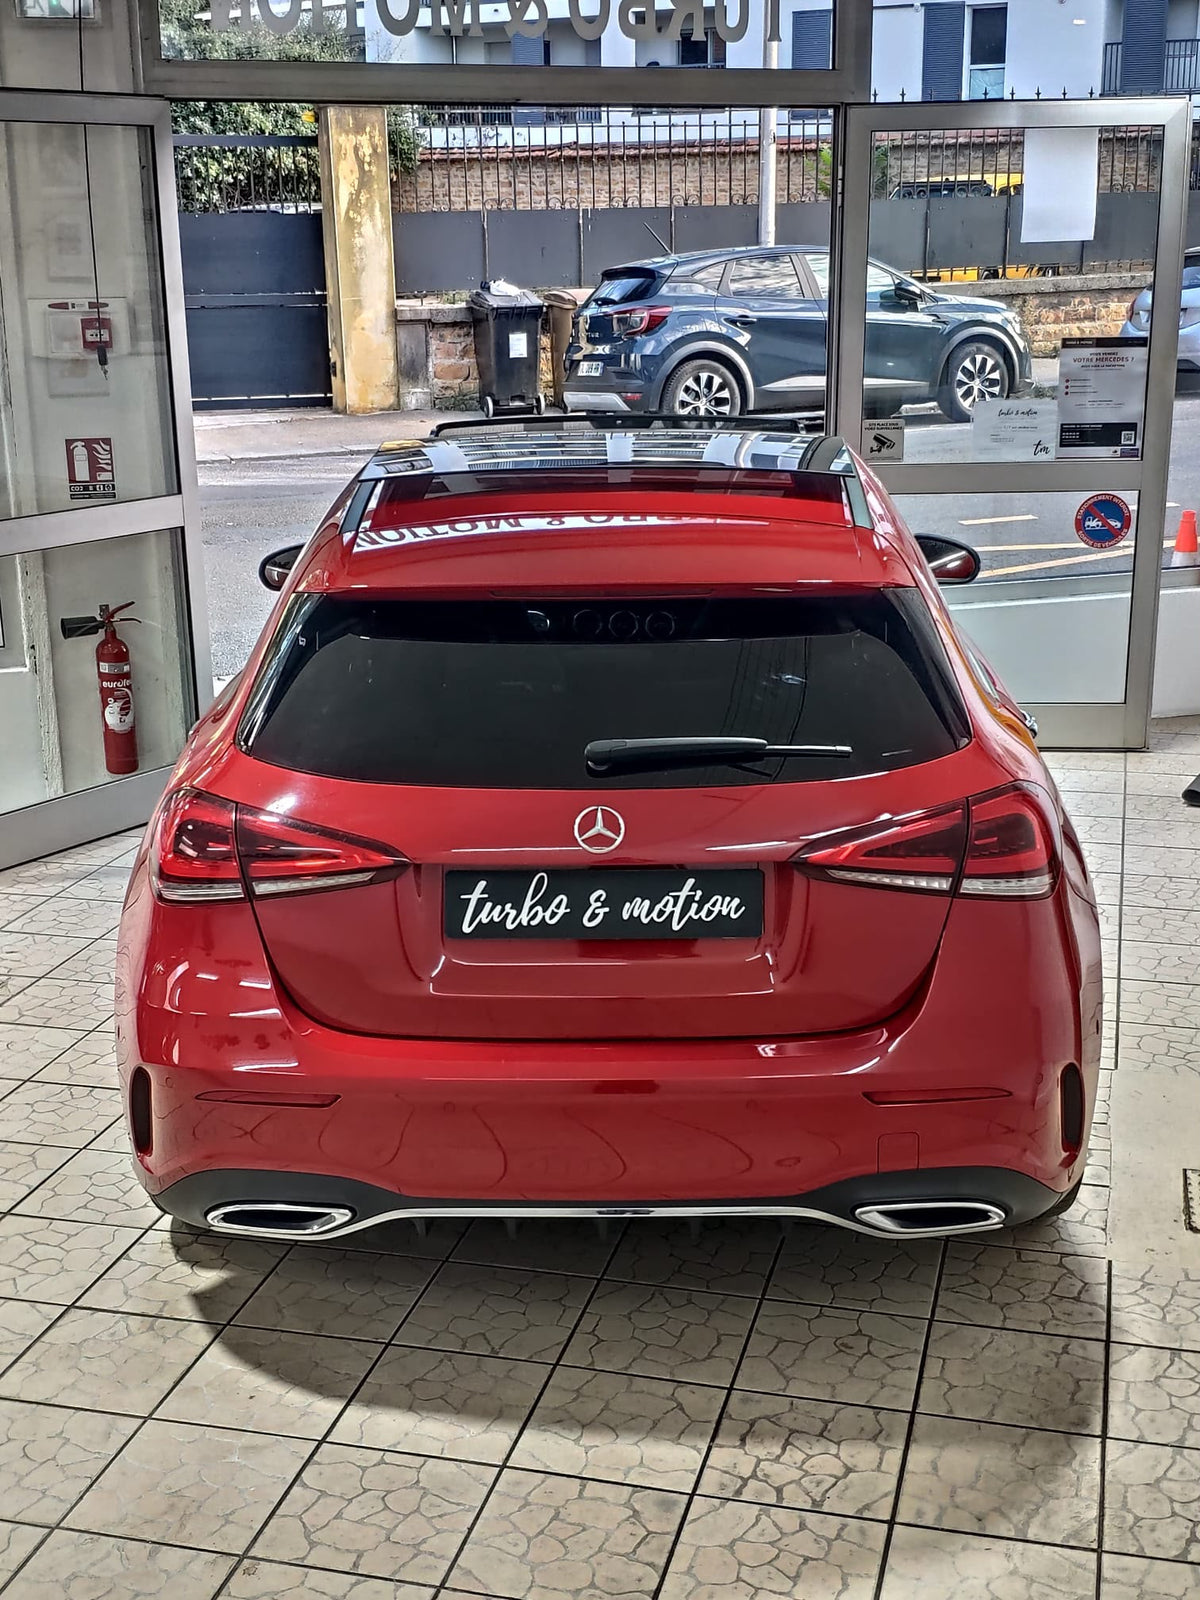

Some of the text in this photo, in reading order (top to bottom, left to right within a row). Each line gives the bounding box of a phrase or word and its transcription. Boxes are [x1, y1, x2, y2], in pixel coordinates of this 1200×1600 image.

[1112, 496, 1129, 517] INTERDIT
[460, 872, 745, 934] turbo & motion
